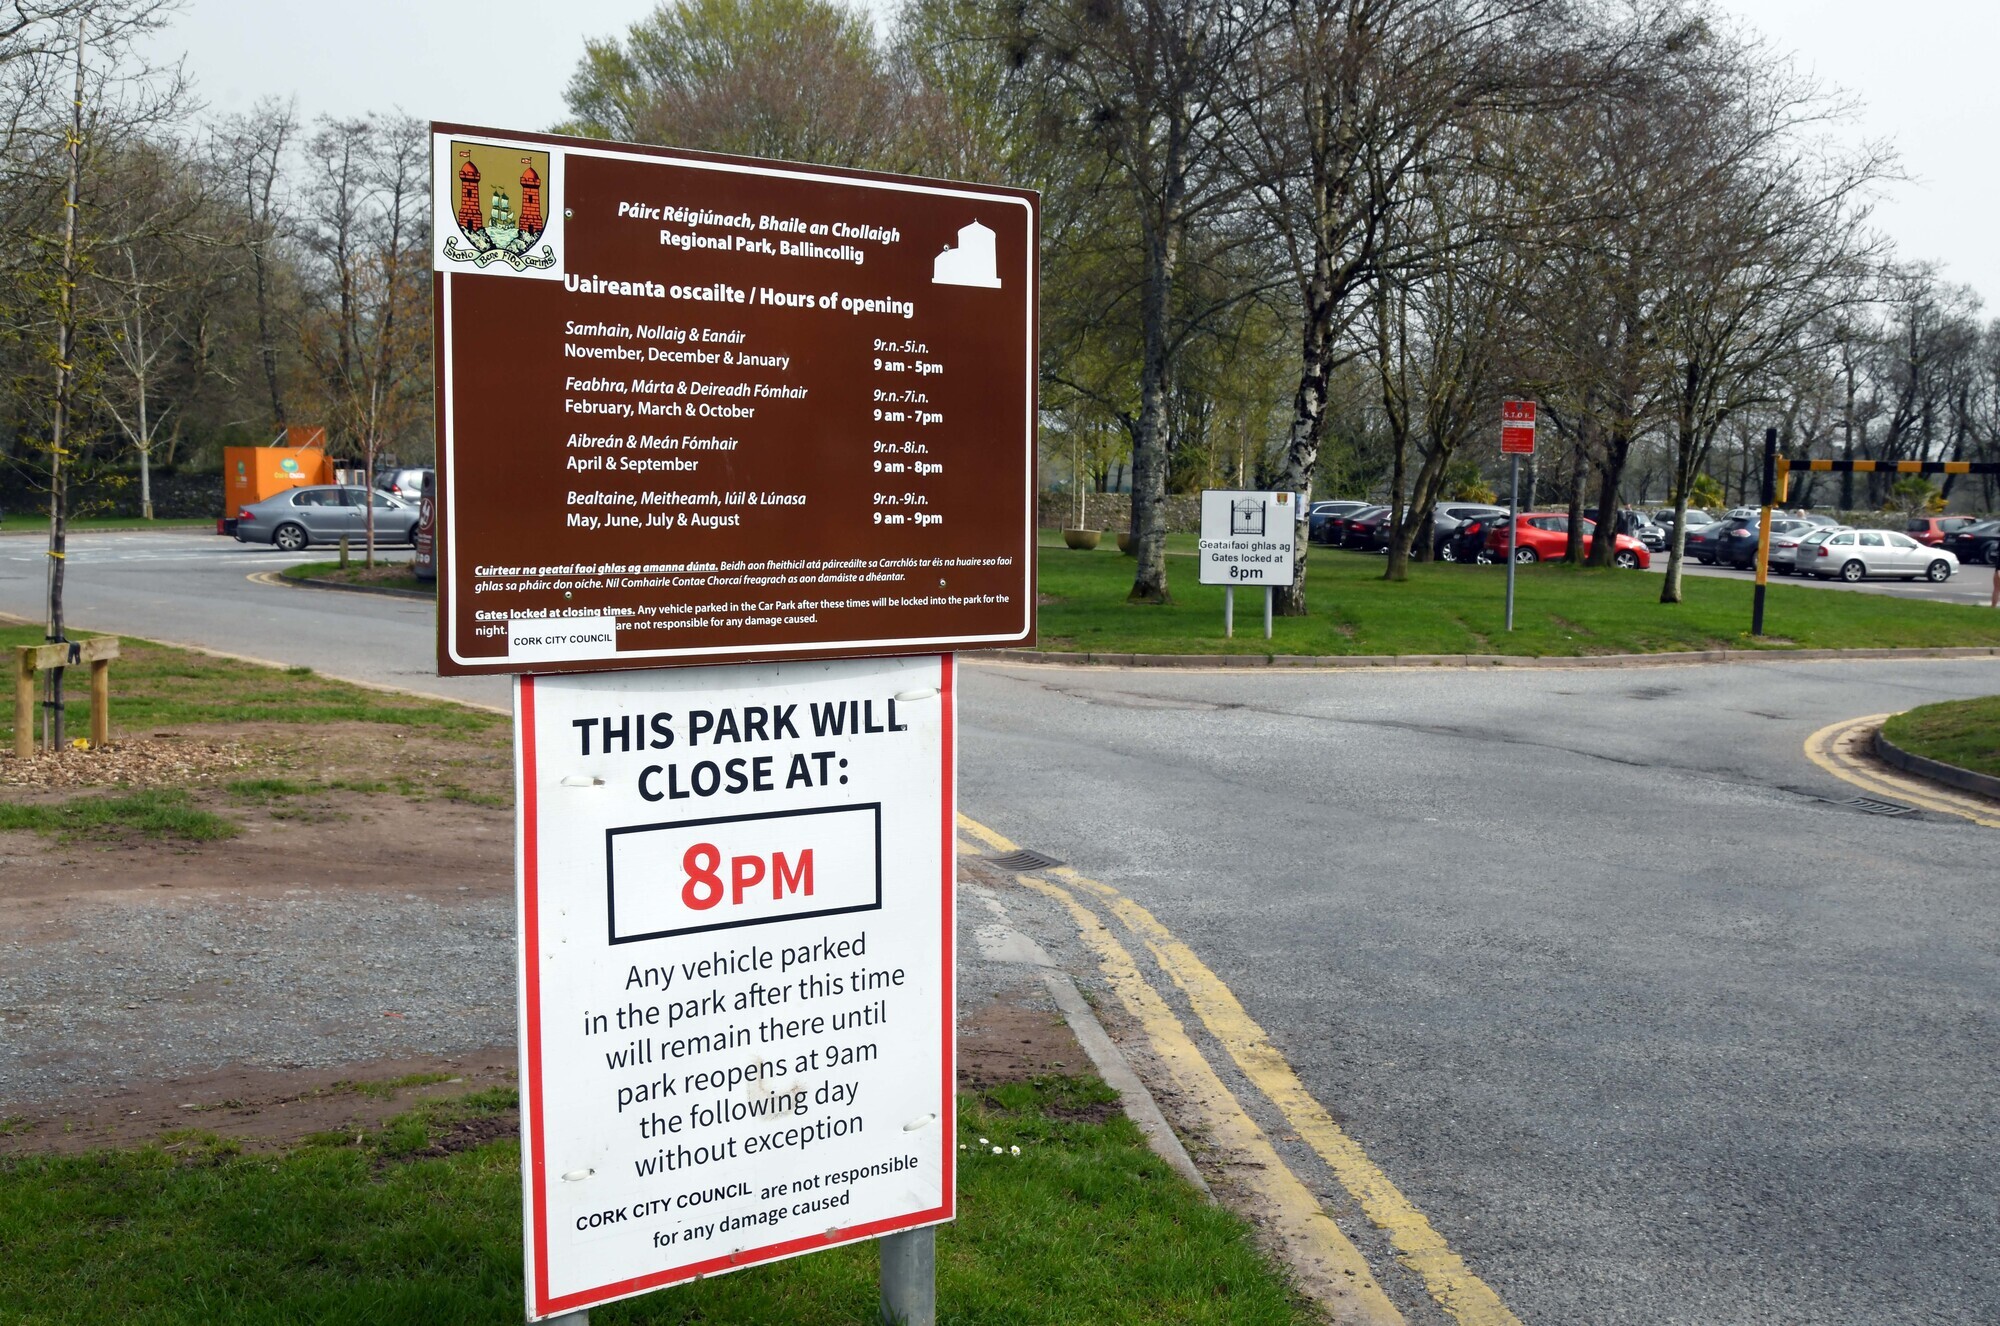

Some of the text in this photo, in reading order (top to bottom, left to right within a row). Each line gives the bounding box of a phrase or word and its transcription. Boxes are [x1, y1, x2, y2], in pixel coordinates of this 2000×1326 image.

[618, 202, 900, 243] Páirc Réigiúnach, Bhaile an Chollaigh
[660, 230, 864, 265] Regional Park, Ballincollig
[564, 274, 913, 319] Uaireanta oscailte Hours of opening
[565, 321, 746, 344] Samhain, Nollaig Eanáir
[565, 343, 790, 370] November, December January
[874, 358, 943, 376] 9 am 5pm
[566, 377, 808, 399] Feabhra, Márta Deireadh Fómhair
[565, 399, 755, 418] February, March October
[873, 409, 943, 426] 9 am 7pm
[566, 433, 738, 450] Aibreán Meán Fómhair
[567, 456, 699, 474] April September
[873, 460, 943, 476] 9 am 8pm
[567, 490, 806, 507] Bealtaine, Meitheamh, Iúil Lúnasa
[567, 512, 740, 530] May, June, July August
[873, 512, 942, 527] 9 am 9pm
[1211, 553, 1283, 563] Gates locked at
[1251, 541, 1277, 552] ghlas
[1279, 543, 1291, 552] ag
[1230, 565, 1263, 581] 8pm
[475, 595, 982, 620] Gates locked closing times. Any vehicle parked Car Park after these times will locked into park
[476, 613, 818, 638] night. are not responsible damage caused.
[514, 634, 612, 646] CORK CITY COUNCIL
[573, 698, 907, 755] THIS PARK WILL
[638, 751, 848, 802] CLOSE AT:
[682, 843, 813, 910] 8PM
[626, 931, 865, 990] Any vehicle parked
[585, 969, 904, 1035] in the park after this time
[606, 1000, 886, 1069] will remain there until
[618, 1044, 877, 1113] park reopens at 9am
[640, 1082, 858, 1139] the following day
[635, 1116, 862, 1177] without exception
[576, 1155, 918, 1230] CORK CITY COUNCIL are not responsible
[653, 1189, 849, 1248] for any damage caused
